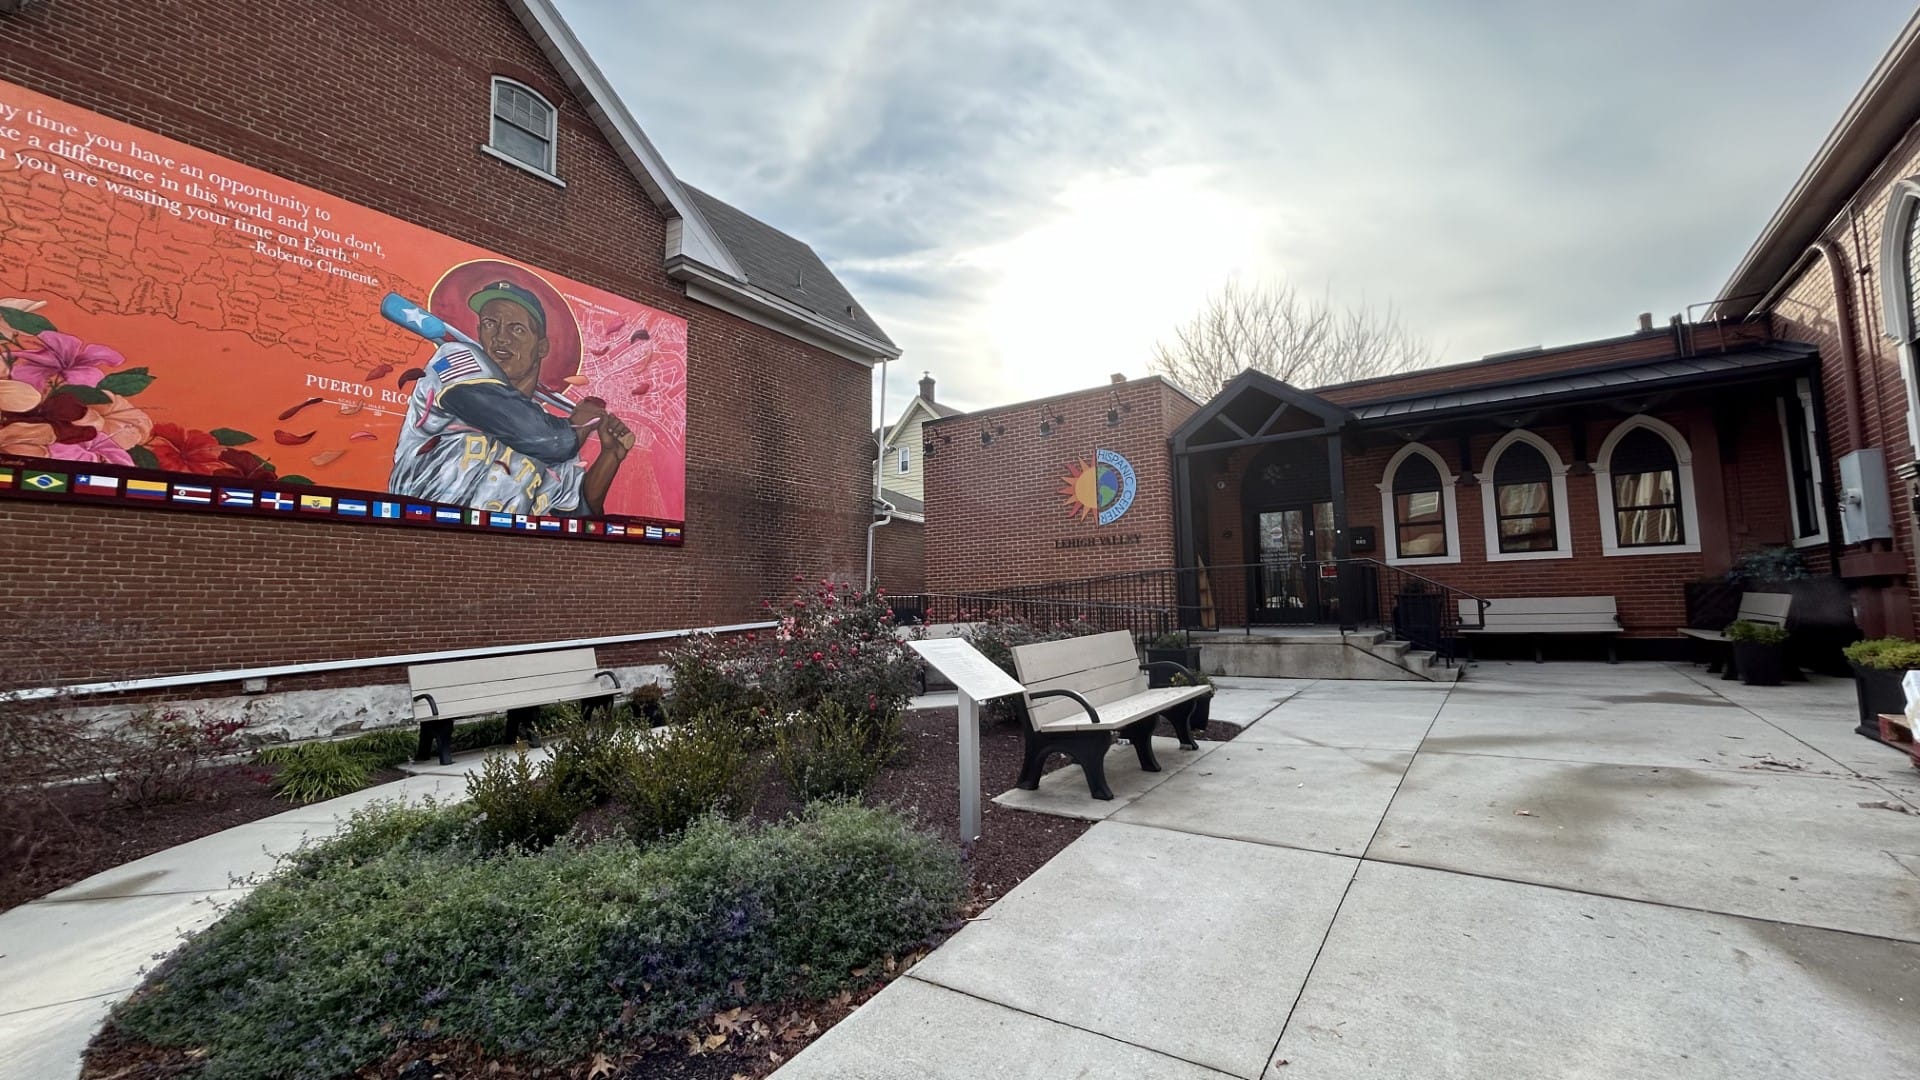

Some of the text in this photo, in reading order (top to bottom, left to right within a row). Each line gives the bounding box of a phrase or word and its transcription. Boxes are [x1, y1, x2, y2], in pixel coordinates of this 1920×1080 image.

[15, 152, 57, 175] you
[63, 168, 98, 187] are
[105, 180, 182, 216] wasting
[187, 205, 230, 225] your
[235, 217, 273, 240] time
[278, 233, 298, 248] on
[27, 109, 78, 137] time
[84, 131, 122, 152] you
[130, 141, 175, 169] have
[180, 163, 204, 180] an
[209, 173, 310, 217] opportunity
[315, 206, 331, 221] to
[28, 135, 42, 149] a
[48, 139, 155, 184] difference
[160, 172, 179, 192] in
[185, 183, 218, 204] this
[224, 197, 273, 221] world
[278, 215, 309, 232] and
[313, 225, 340, 242] you
[345, 234, 385, 259] don't,
[316, 259, 379, 287] Clemente
[305, 374, 373, 398] PUERTO
[1097, 450, 1134, 524] HISPANIC CENTER
[1055, 533, 1141, 549] LEHIGH VALLEY
